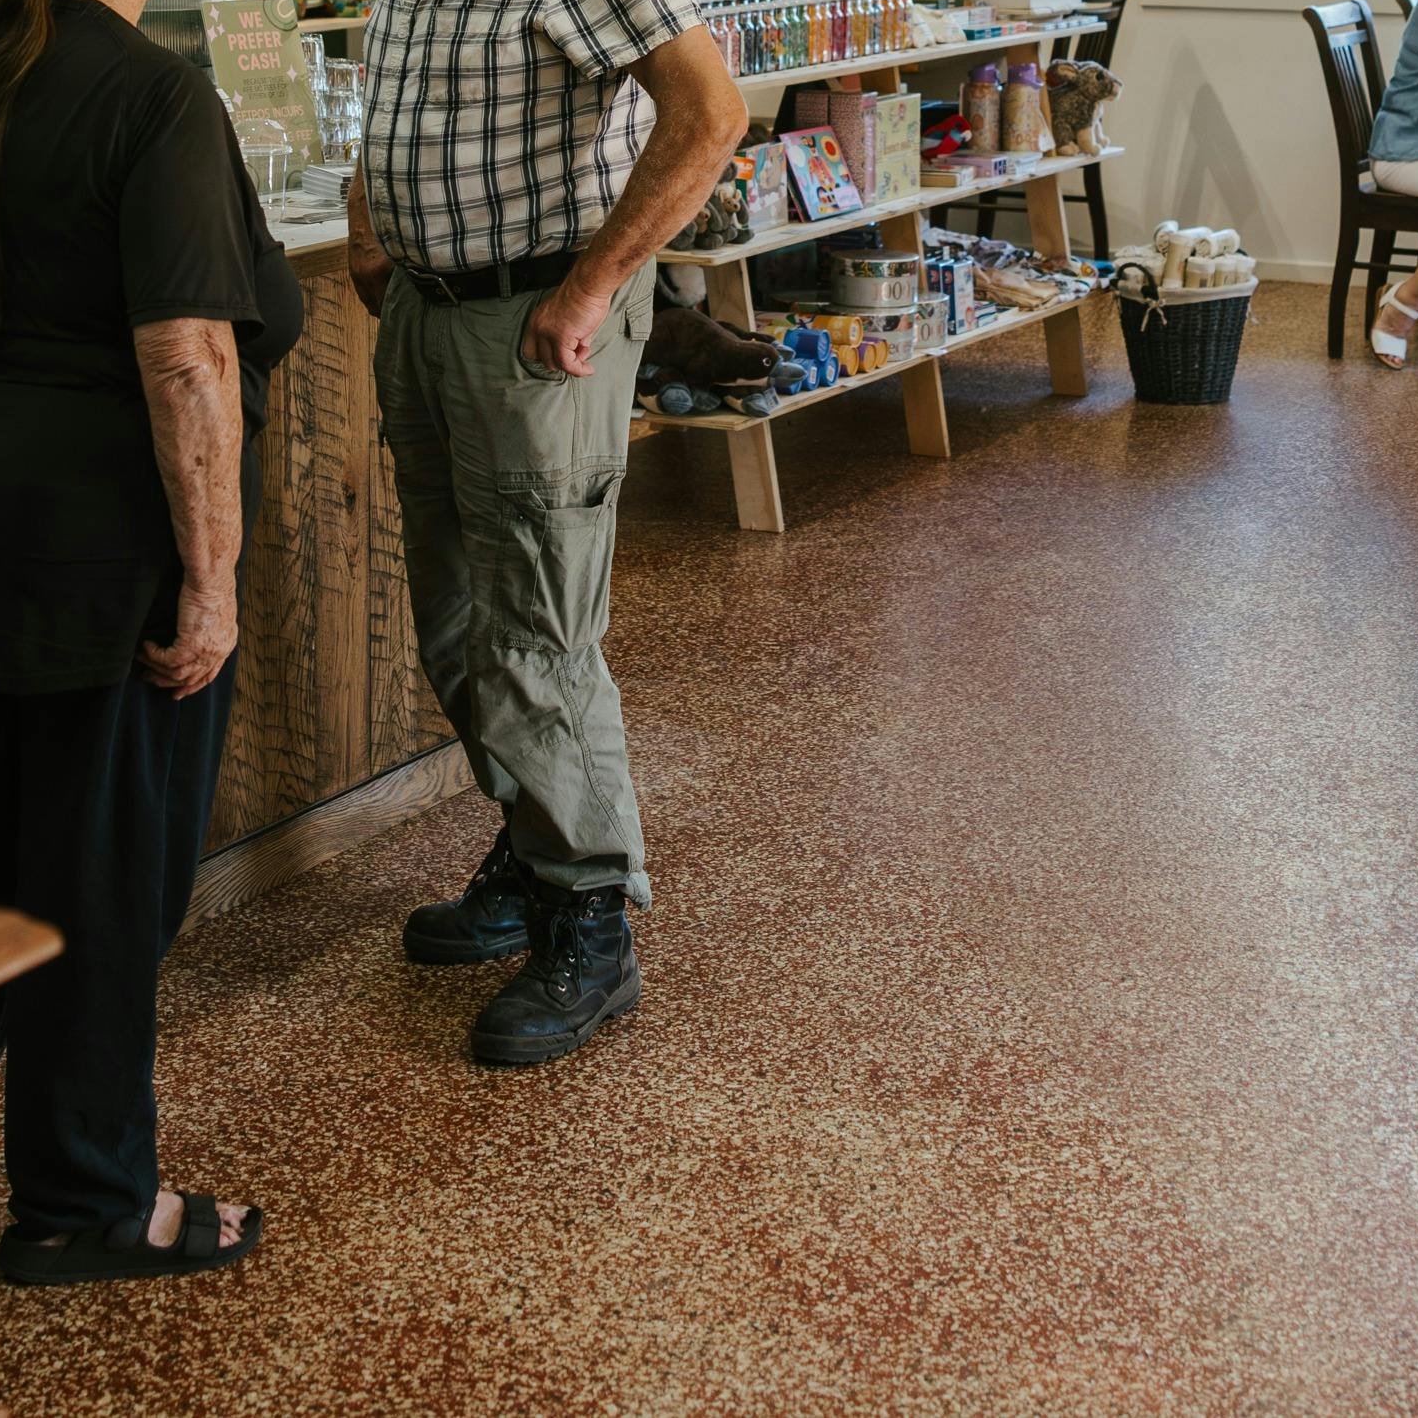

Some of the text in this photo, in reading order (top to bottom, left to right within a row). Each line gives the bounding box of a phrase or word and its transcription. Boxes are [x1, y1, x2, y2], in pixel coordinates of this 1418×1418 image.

[238, 12, 264, 29] WE
[227, 31, 283, 52] PREFER
[237, 52, 281, 71] CASH
